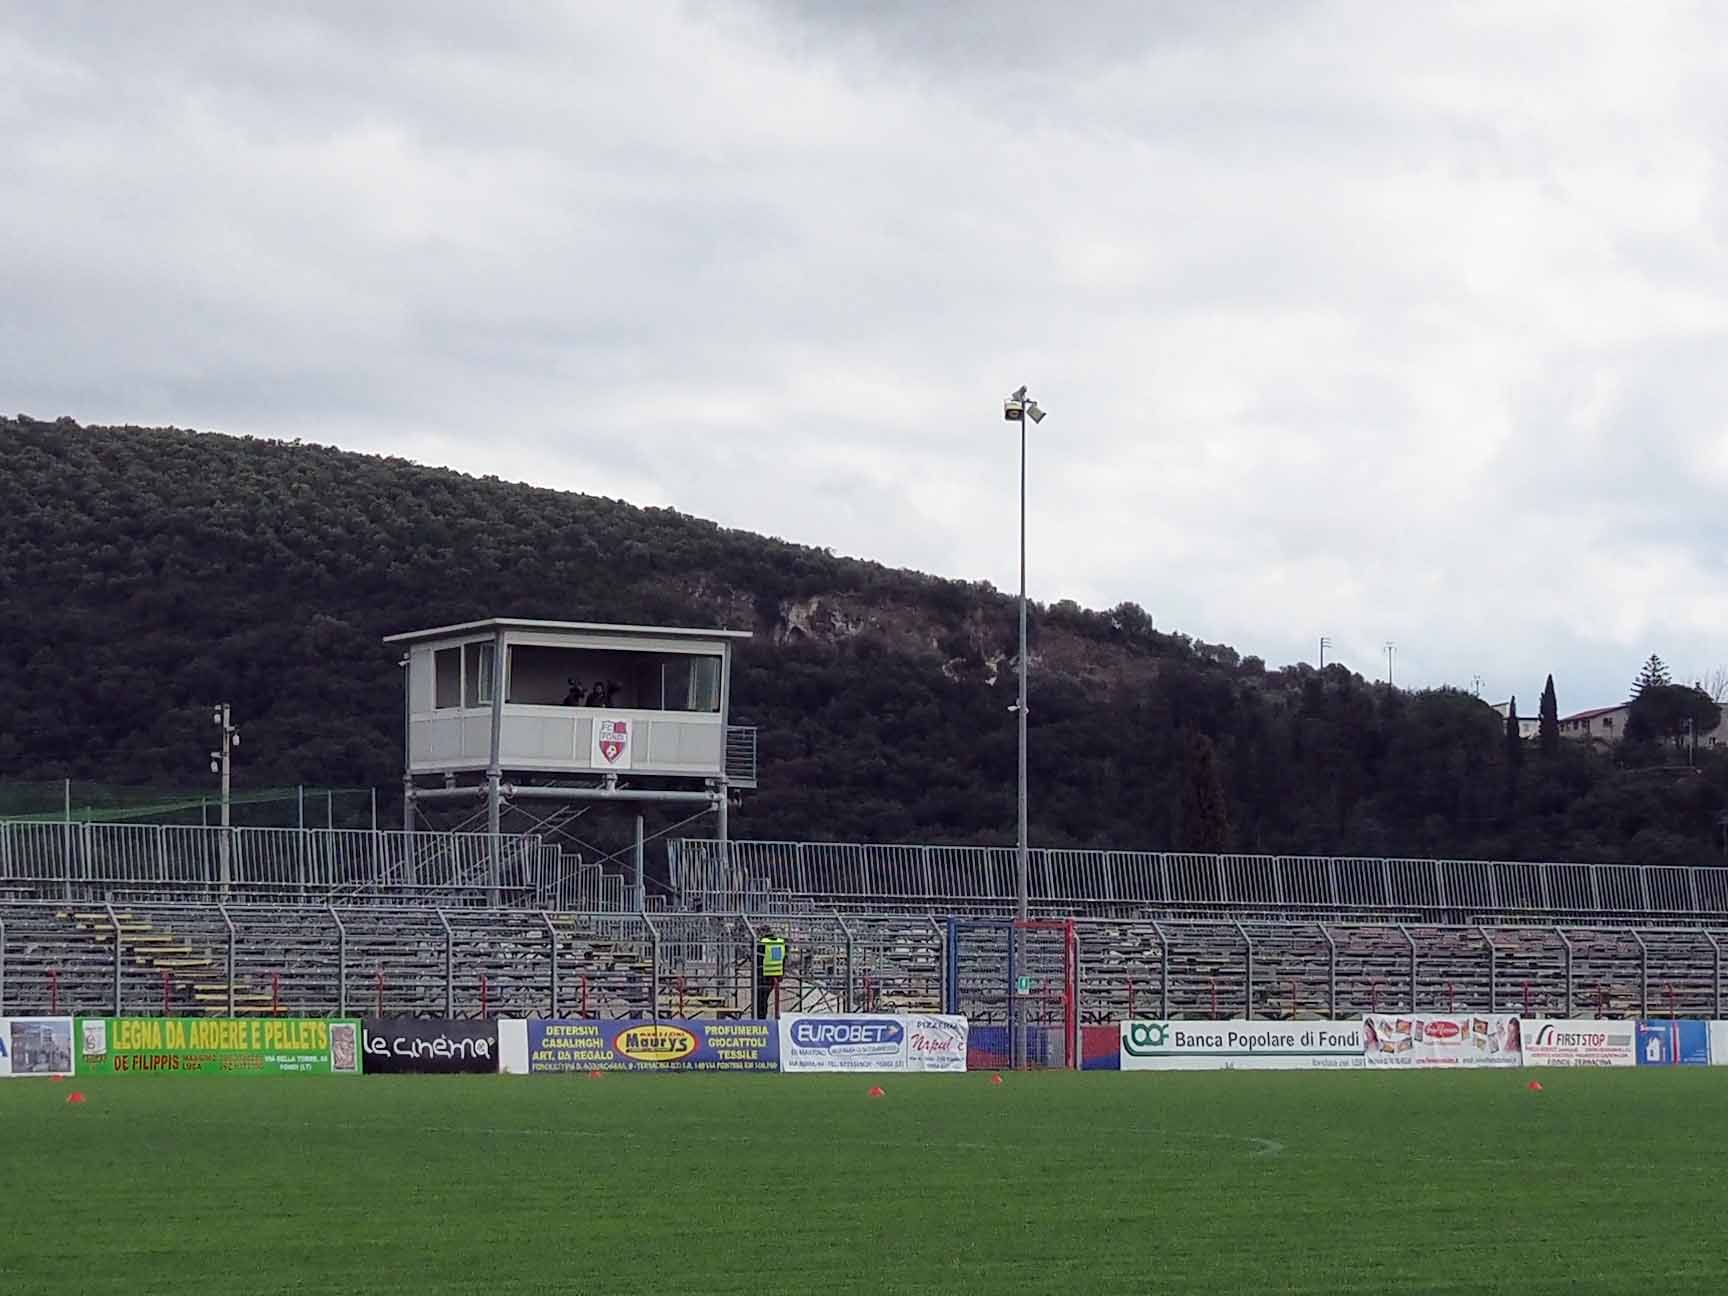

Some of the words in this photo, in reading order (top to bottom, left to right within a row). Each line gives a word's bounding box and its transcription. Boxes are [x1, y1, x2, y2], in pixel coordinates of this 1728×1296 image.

[113, 1020, 161, 1050] LEGNA
[166, 1020, 185, 1050] DA
[190, 1020, 248, 1050] ARDERE
[252, 1021, 261, 1050] E
[264, 1021, 327, 1050] PELLETS
[546, 1026, 598, 1036] DETERSIVI
[704, 1025, 768, 1036] PROFUMERIA
[798, 1025, 887, 1042] EUROBET
[363, 1029, 391, 1057] le
[542, 1038, 604, 1049] CASALINGHI
[708, 1038, 766, 1048] GIOCATTOLI
[1175, 1031, 1223, 1047] Banca
[1228, 1031, 1295, 1050] Popolare
[1300, 1031, 1314, 1047] di
[1319, 1031, 1360, 1047] Fondi
[532, 1051, 555, 1061] ART.
[574, 1051, 614, 1061] REGALO
[718, 1050, 758, 1060] TESSILE
[114, 1055, 129, 1071] DE
[132, 1054, 179, 1071] FILIPPIS
